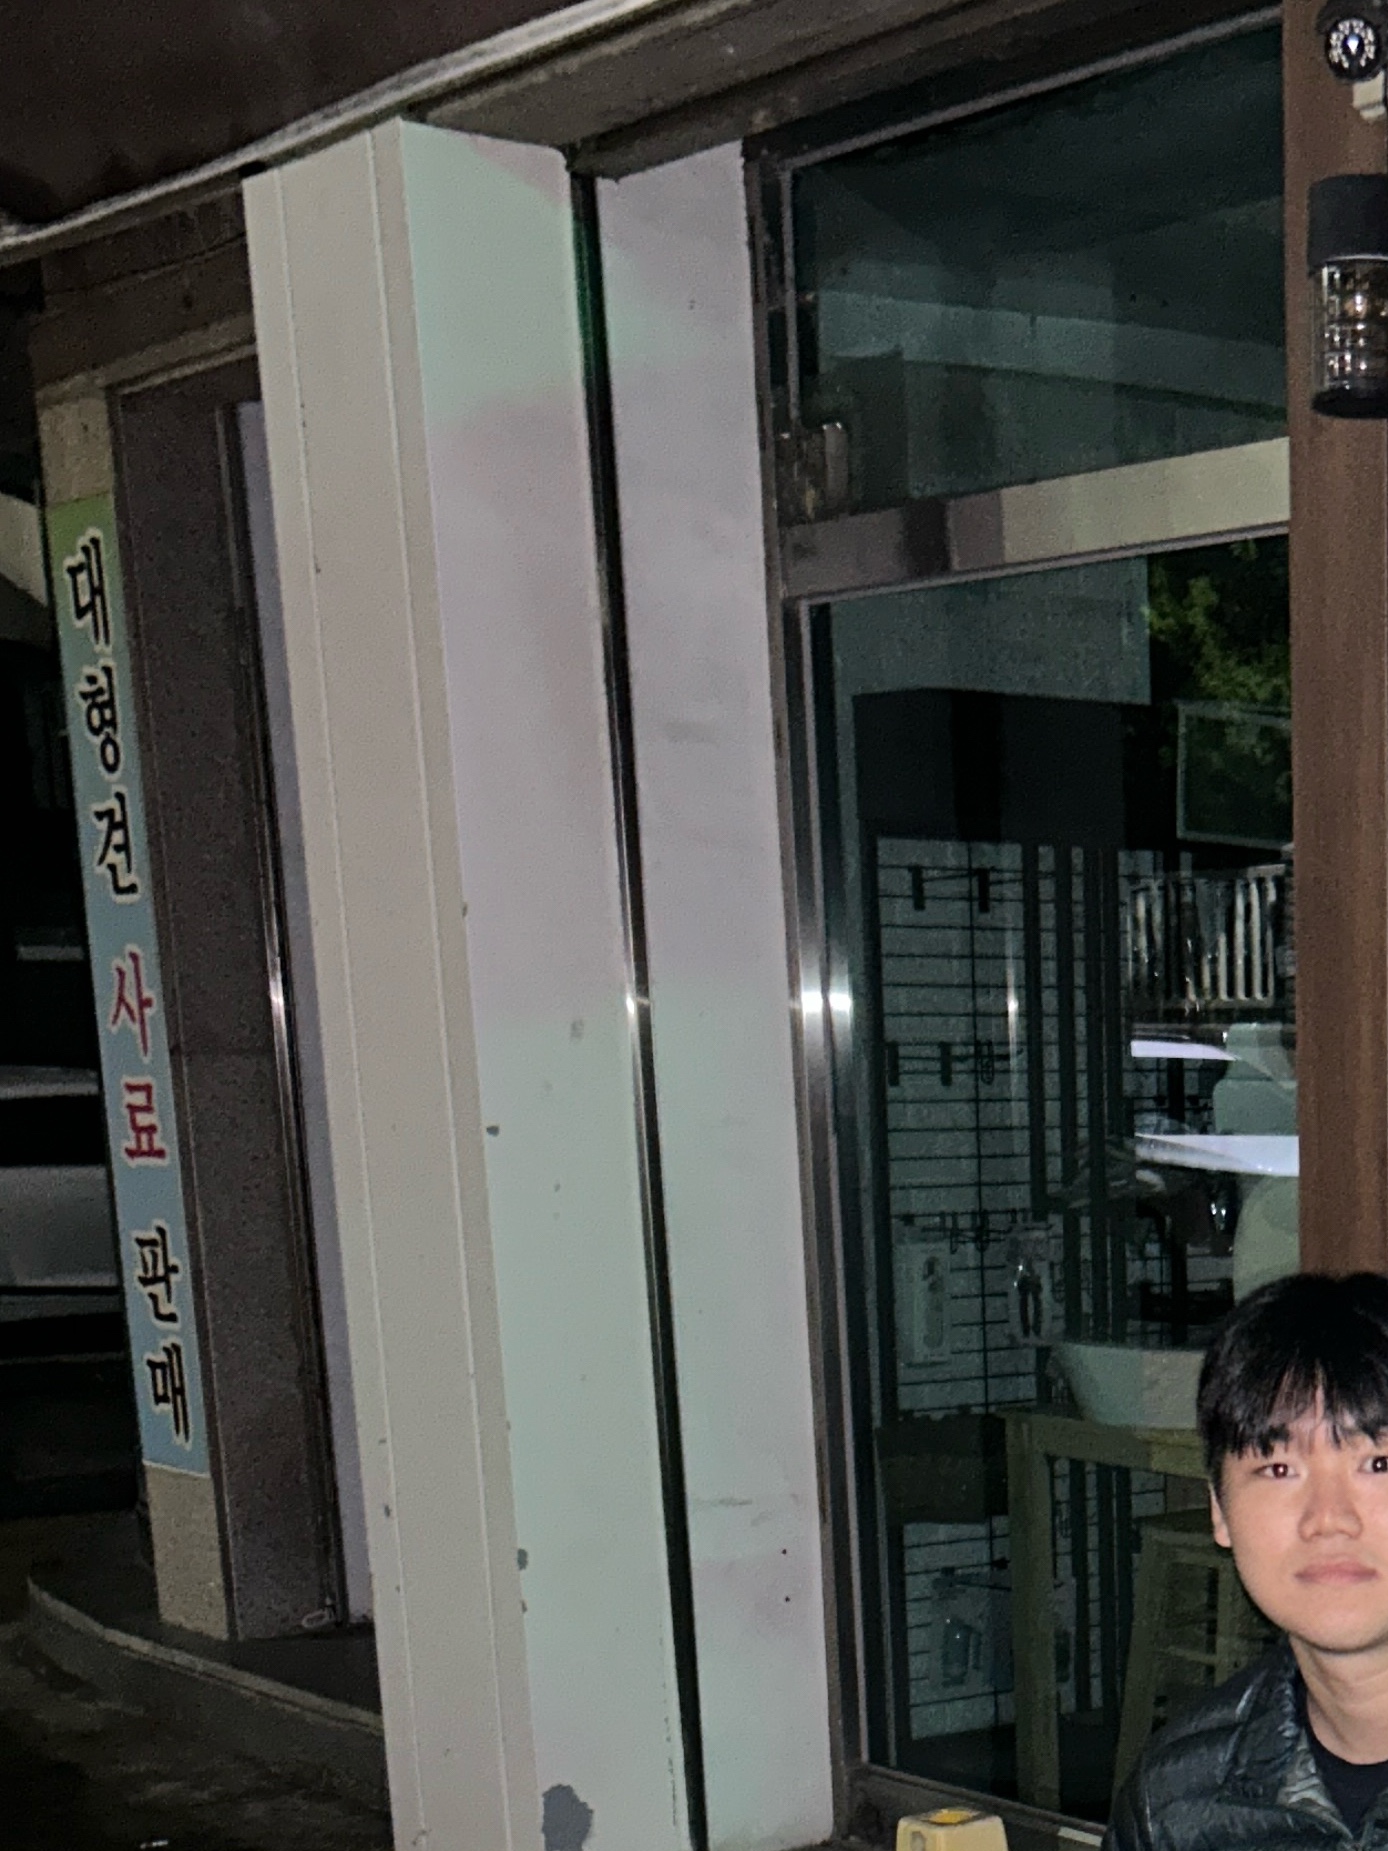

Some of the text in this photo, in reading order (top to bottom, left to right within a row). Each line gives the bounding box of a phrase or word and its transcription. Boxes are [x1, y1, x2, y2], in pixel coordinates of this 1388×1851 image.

[66, 535, 191, 1443] 대형견 사료 판매
